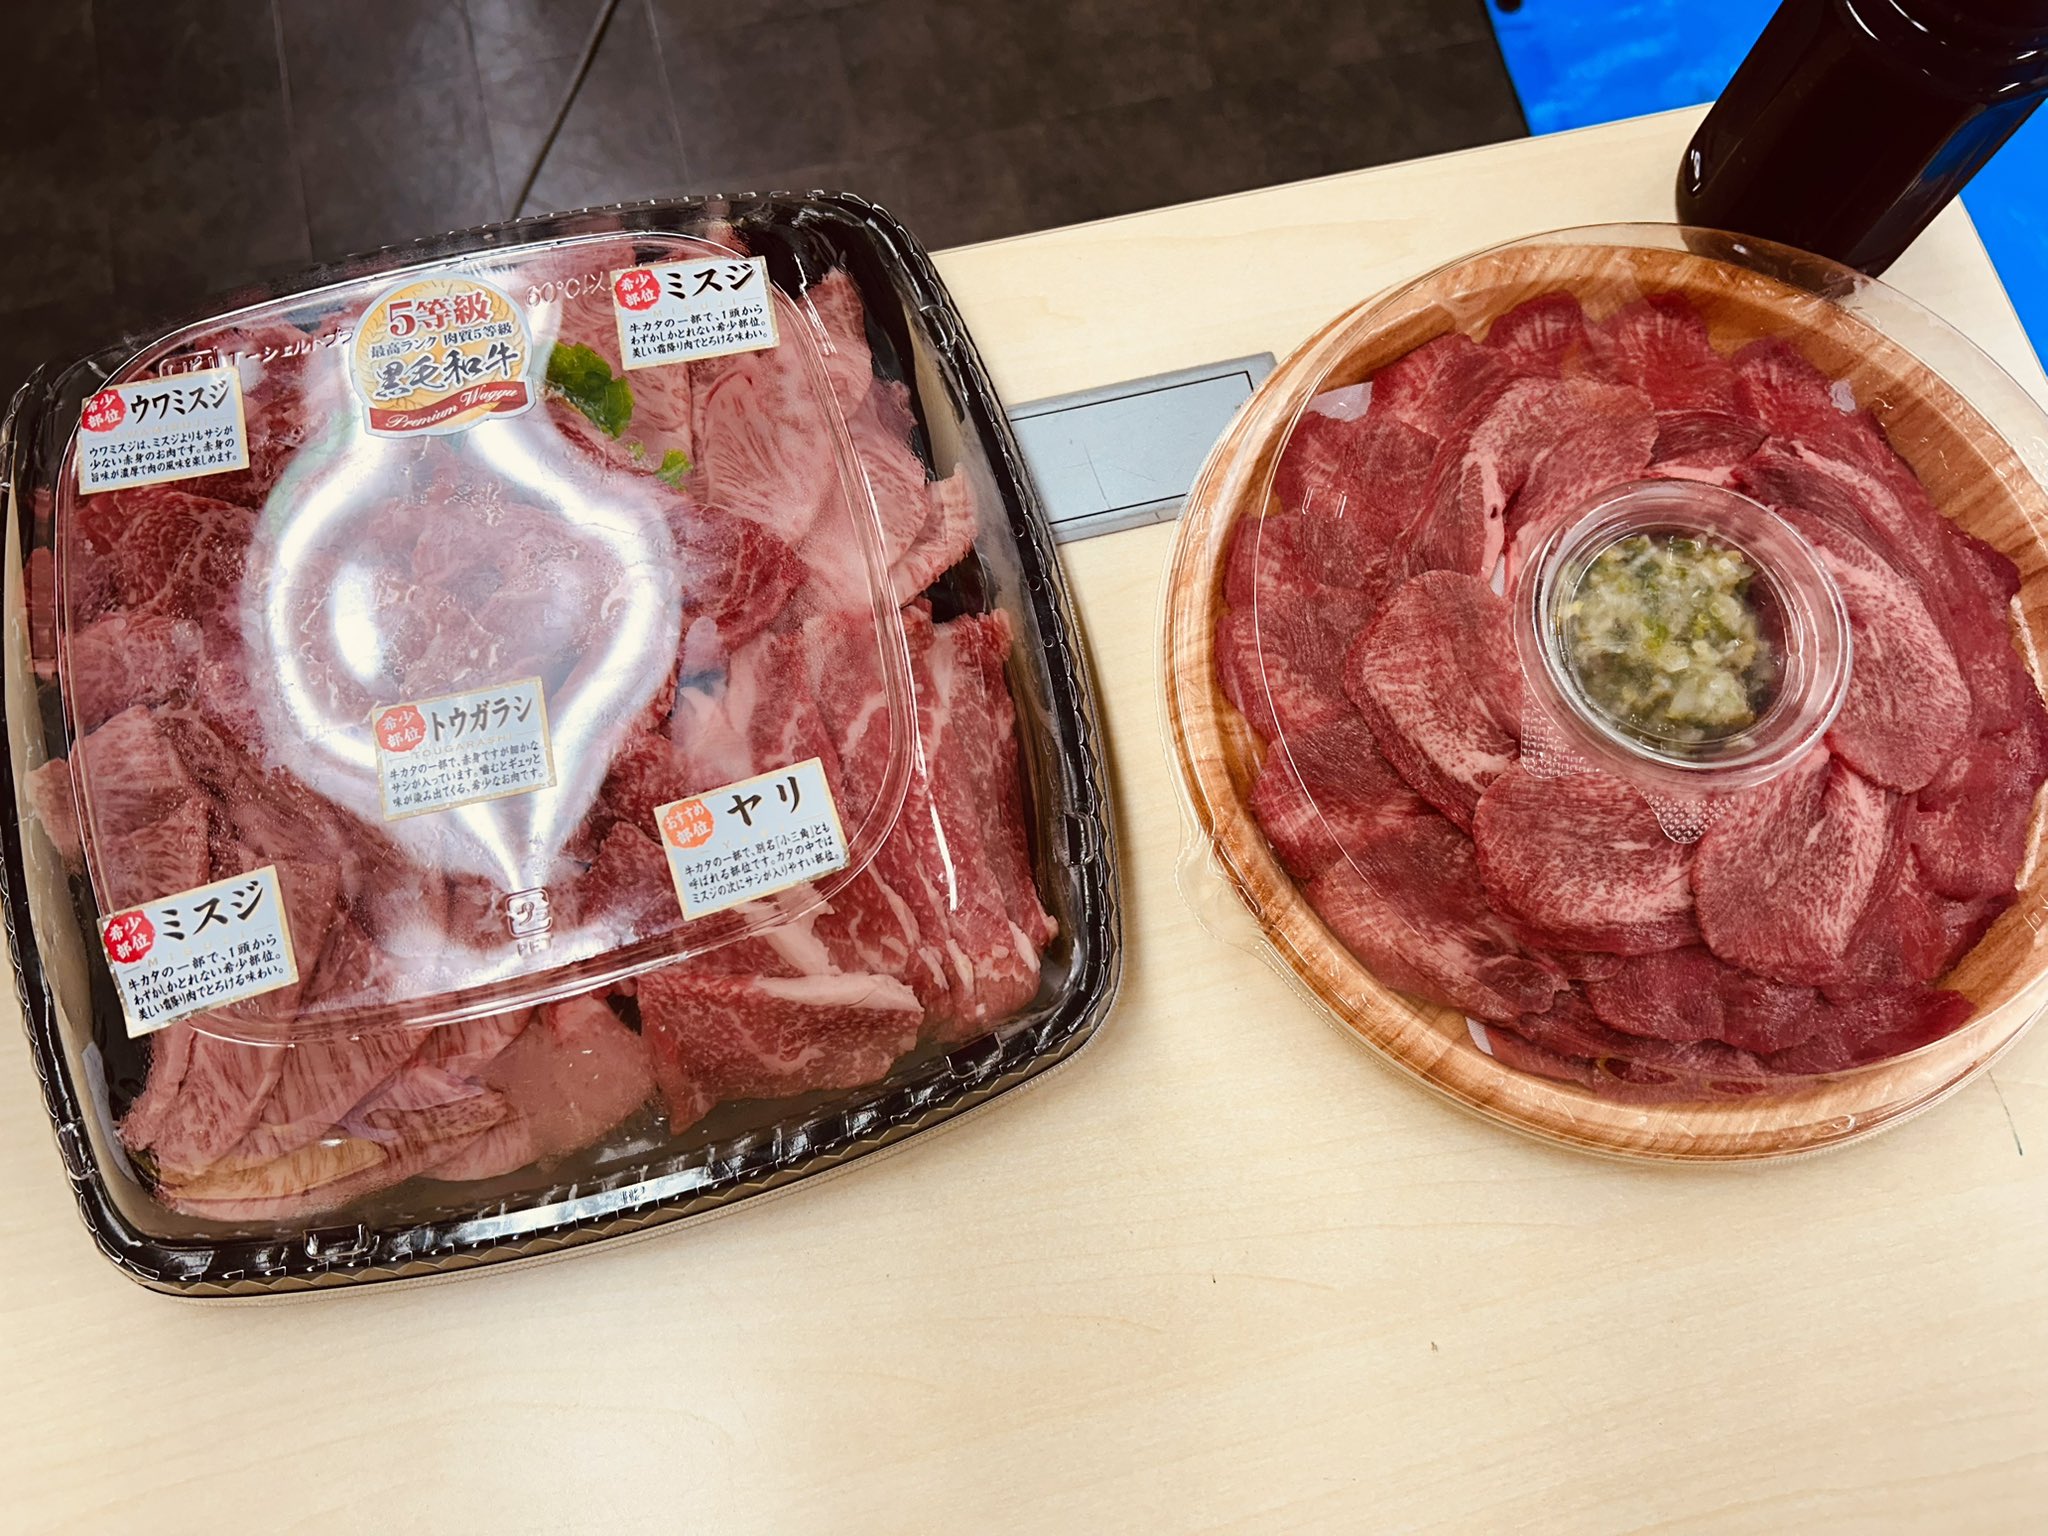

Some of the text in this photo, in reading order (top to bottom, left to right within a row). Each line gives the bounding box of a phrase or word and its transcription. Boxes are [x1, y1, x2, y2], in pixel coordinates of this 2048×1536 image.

[621, 273, 650, 291] 希少
[625, 288, 657, 306] 部位
[667, 263, 755, 299] ミスジ
[389, 290, 492, 336] 5等級
[630, 304, 763, 333] 牛カタの一部で、1頭から
[371, 323, 513, 359] 最高ランク 肉質5等級
[631, 318, 765, 345] わずかしかとれない希少部位。
[632, 329, 767, 358] 美しい霜降り肉でとろける味わい。
[376, 342, 518, 398] 黒毛和牛
[86, 393, 116, 414] 希少
[87, 408, 121, 428] 部位
[130, 379, 229, 424] ウワミスジ
[386, 385, 518, 428] Premium Wagyu
[90, 425, 233, 458] ウワミスジは、ミスジよりもサシが
[90, 438, 234, 470] 少ない赤身のお肉です。赤身の
[91, 451, 237, 483] 旨味が濃厚で肉の風味を楽しめます。
[383, 710, 415, 731] 希少
[431, 696, 532, 742] トウガラシ
[387, 726, 422, 747] 部位
[413, 734, 512, 758] TOUGARASHI
[390, 740, 539, 780] 牛カタの一部で、赤身ですが細かな
[393, 767, 543, 808] 味が染み出てくる、希少なお肉です。
[727, 776, 800, 827] ヤリ
[666, 804, 705, 829] おすすめ
[677, 823, 711, 844] 部位
[685, 822, 830, 876] 牛カタの一部で、別名「小三角」とも
[689, 836, 834, 890] 呼ばれる部位です。カタの中では
[692, 850, 840, 903] ミスジの次にサシが入りやすい部位。
[161, 880, 263, 940] ミスジ
[109, 917, 142, 941] 希少
[116, 933, 150, 959] 部位
[128, 934, 277, 990] 牛カタの一部で、1頭から
[134, 951, 280, 1006] わずかしかとれない希少部位。
[138, 966, 283, 1021] 美しい霜降り肉でとろける味わい。
